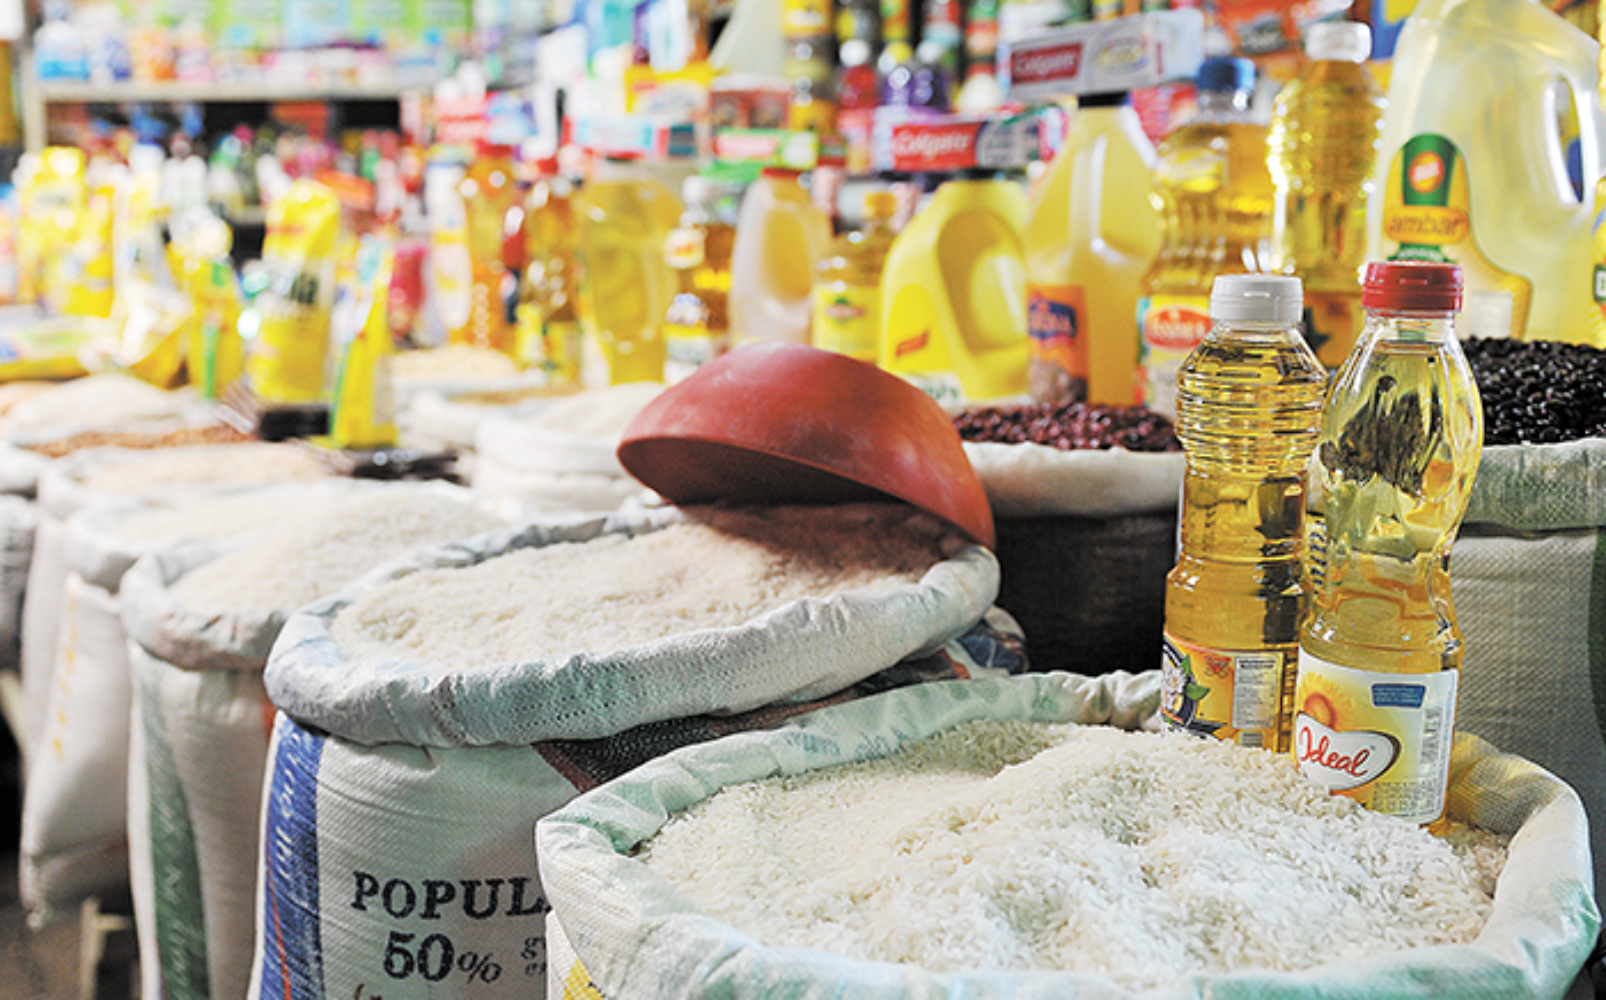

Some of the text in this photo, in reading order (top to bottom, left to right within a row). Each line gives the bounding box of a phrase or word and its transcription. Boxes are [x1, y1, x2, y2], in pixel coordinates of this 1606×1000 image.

[1015, 52, 1075, 76] Colgate
[899, 129, 969, 160] Colgate
[1390, 213, 1466, 236] ambar
[1299, 726, 1370, 777] Ideal
[351, 871, 553, 919] POPUL
[384, 931, 502, 984] 50%
